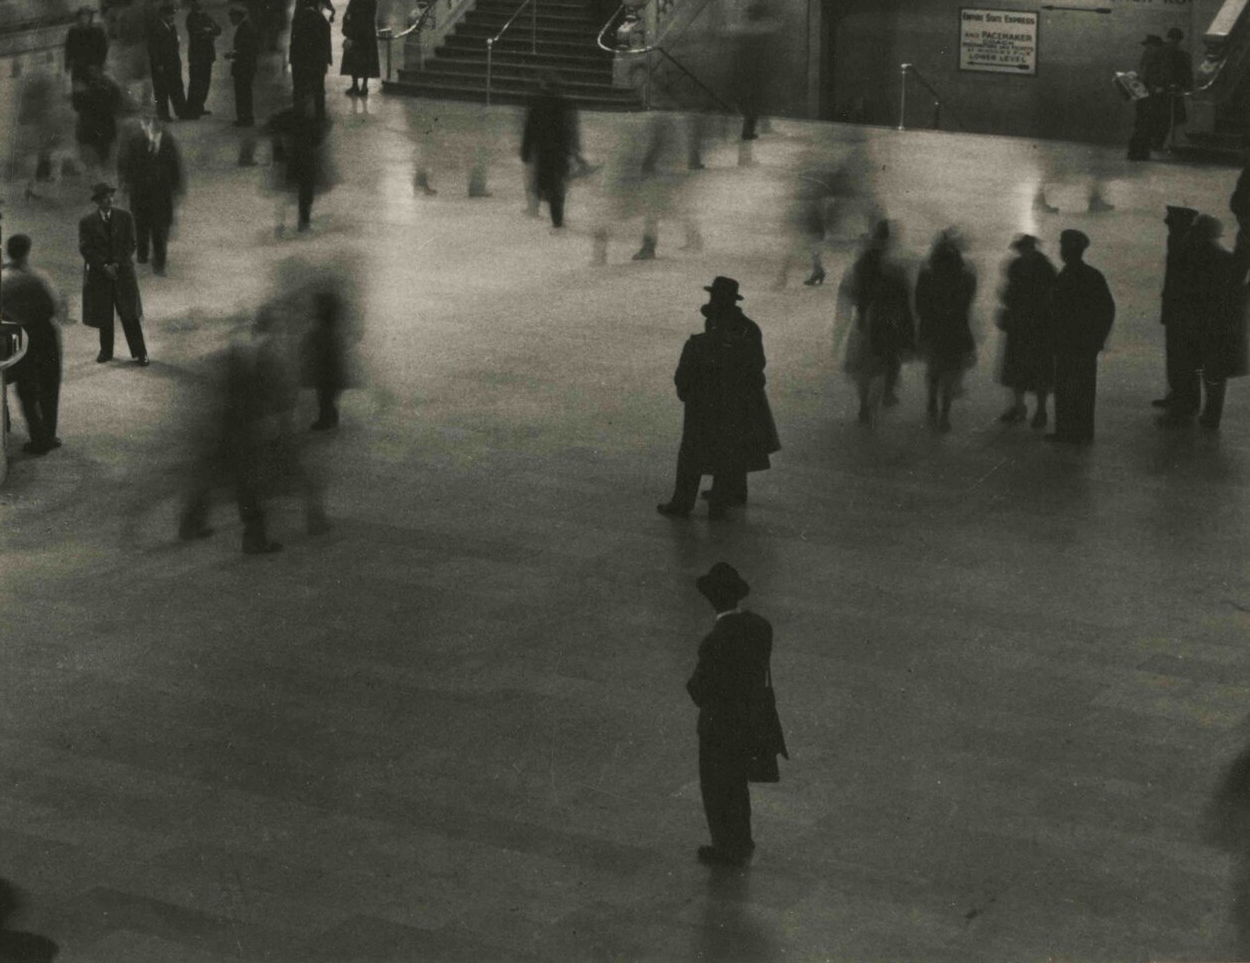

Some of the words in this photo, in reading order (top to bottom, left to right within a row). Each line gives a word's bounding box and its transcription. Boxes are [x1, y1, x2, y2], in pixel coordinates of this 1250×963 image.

[1004, 14, 1035, 25] EXPRESS
[982, 31, 1032, 42] PACEMAKER
[969, 53, 996, 61] LOWER
